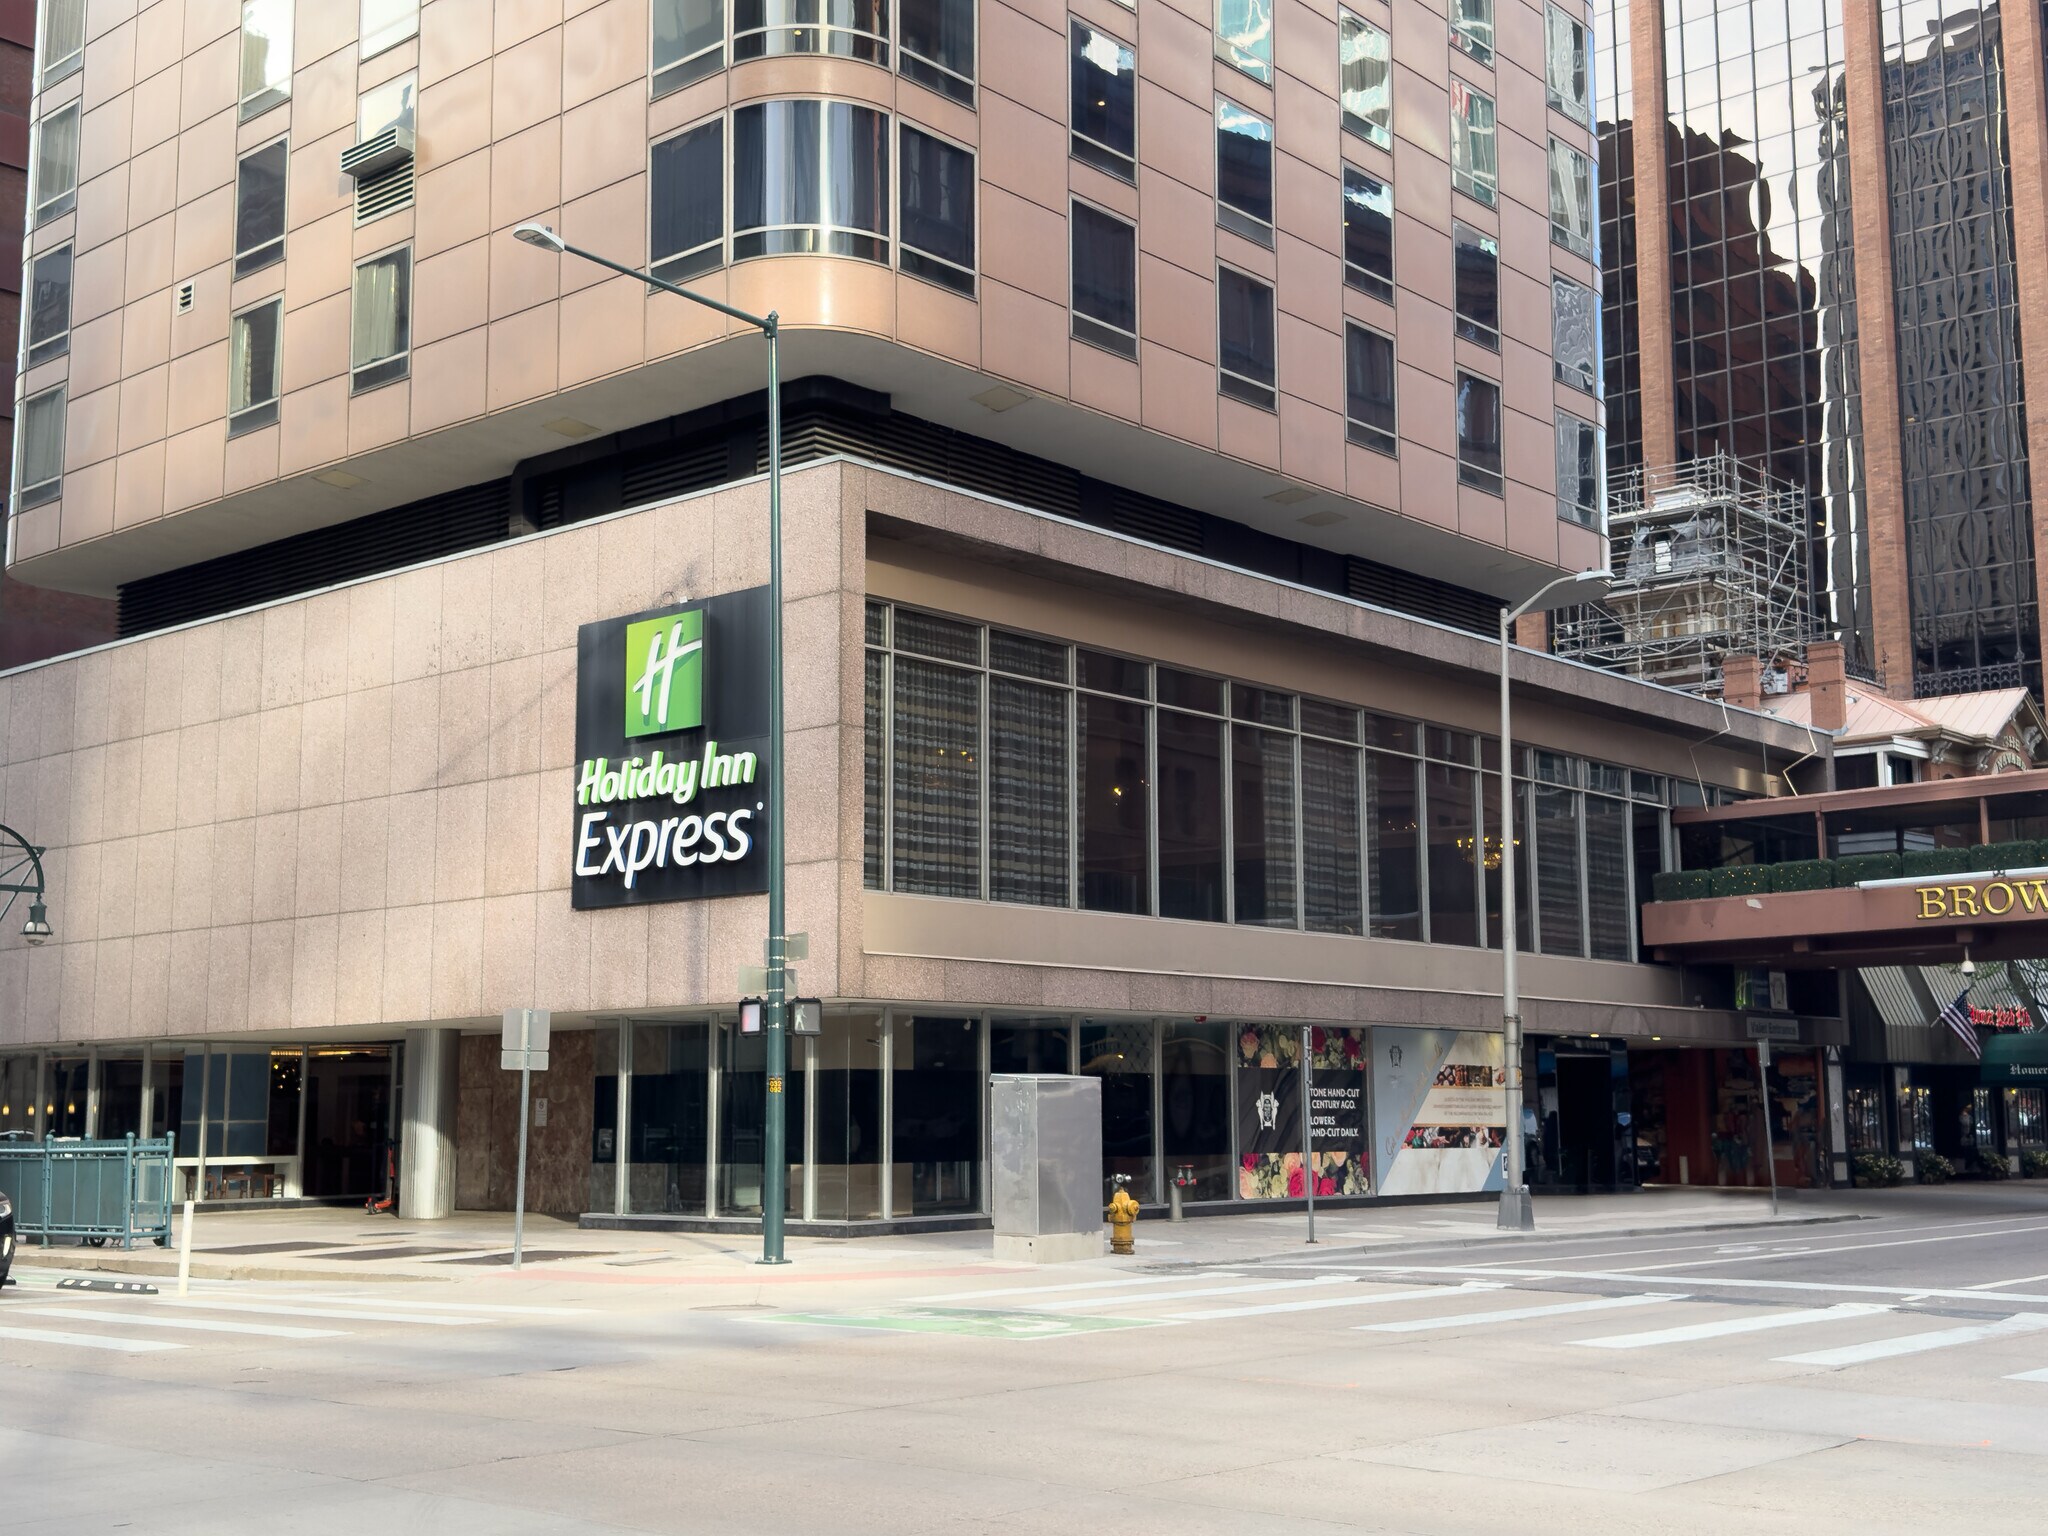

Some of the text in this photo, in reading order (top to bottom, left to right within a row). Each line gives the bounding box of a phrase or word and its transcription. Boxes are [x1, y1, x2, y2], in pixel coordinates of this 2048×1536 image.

[577, 740, 757, 805] Holiday Inn
[575, 809, 754, 890] Express
[1915, 880, 2048, 919] BROW
[2009, 1063, 2048, 1080] Homer
[1309, 1088, 1360, 1098] TONE HAND-CUT
[1311, 1099, 1356, 1110] CENTURY AGO.
[1310, 1116, 1336, 1126] LOWERS
[1340, 1128, 1359, 1137] DAILY.
